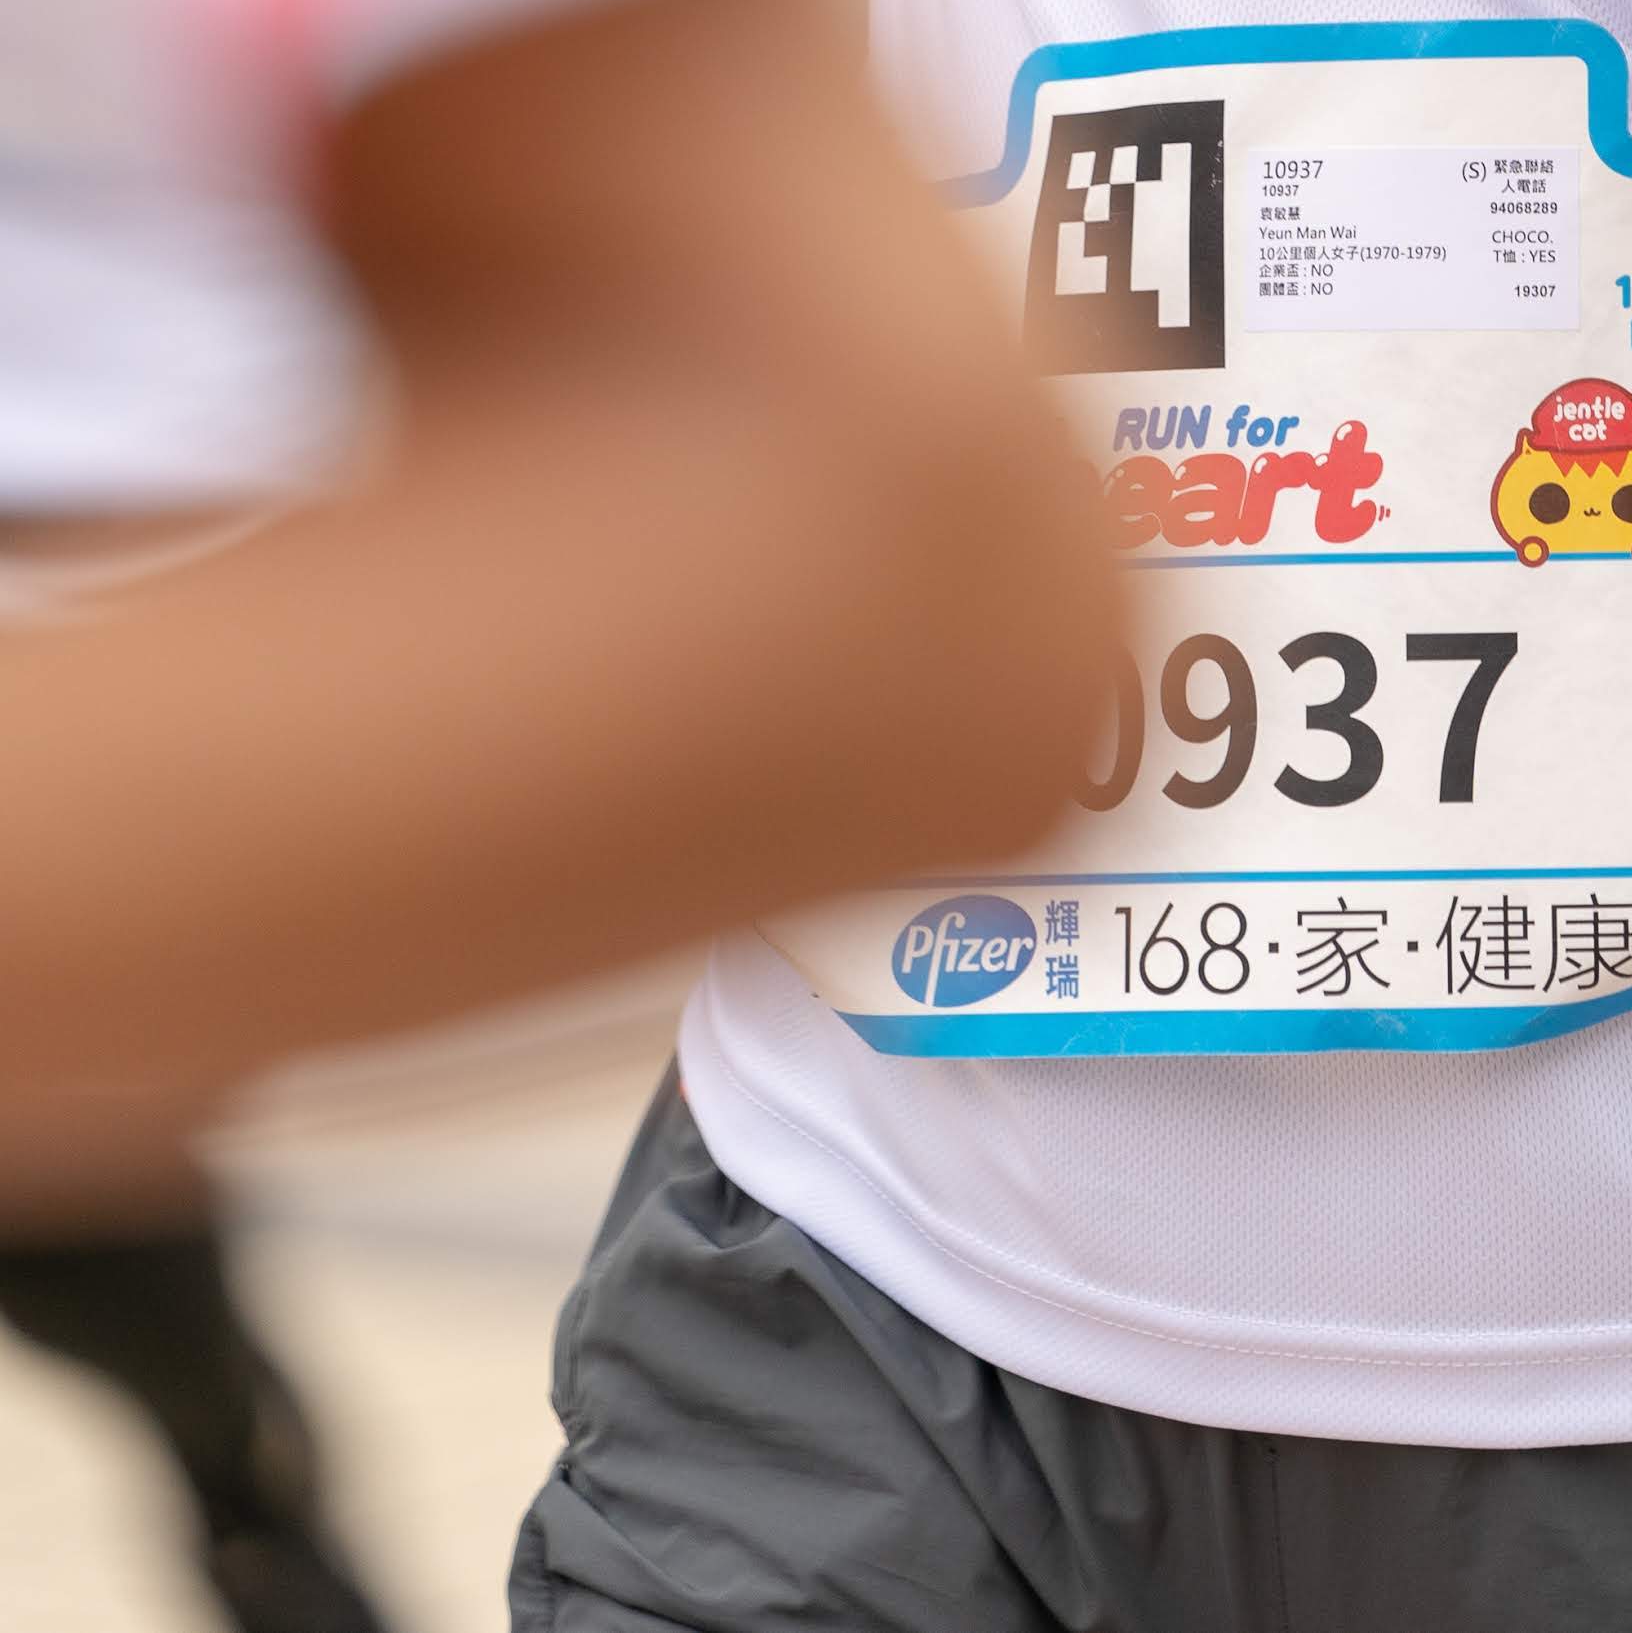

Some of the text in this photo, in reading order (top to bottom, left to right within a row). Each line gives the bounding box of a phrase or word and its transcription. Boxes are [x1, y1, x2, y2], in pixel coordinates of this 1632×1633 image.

[1263, 160, 1324, 179] 10937
[1462, 161, 1487, 183] (S)
[1494, 159, 1554, 174] 緊急聯絡
[1262, 185, 1299, 197] 10937
[1501, 178, 1546, 193] 人電話
[1490, 201, 1558, 214] 94068289
[1259, 225, 1357, 240] Yeun Man Wai
[1529, 250, 1556, 263] YES
[1311, 263, 1334, 277] NO
[1311, 282, 1334, 295] NO
[1514, 284, 1556, 297] 19307
[1553, 395, 1626, 423] jentle
[1112, 404, 1300, 452] RUN for
[1568, 419, 1609, 442] cat
[1098, 419, 1384, 550] eart
[1070, 631, 1518, 812] 0937
[1045, 899, 1081, 1000] 輝瑞
[901, 910, 1035, 1008] Pfizer
